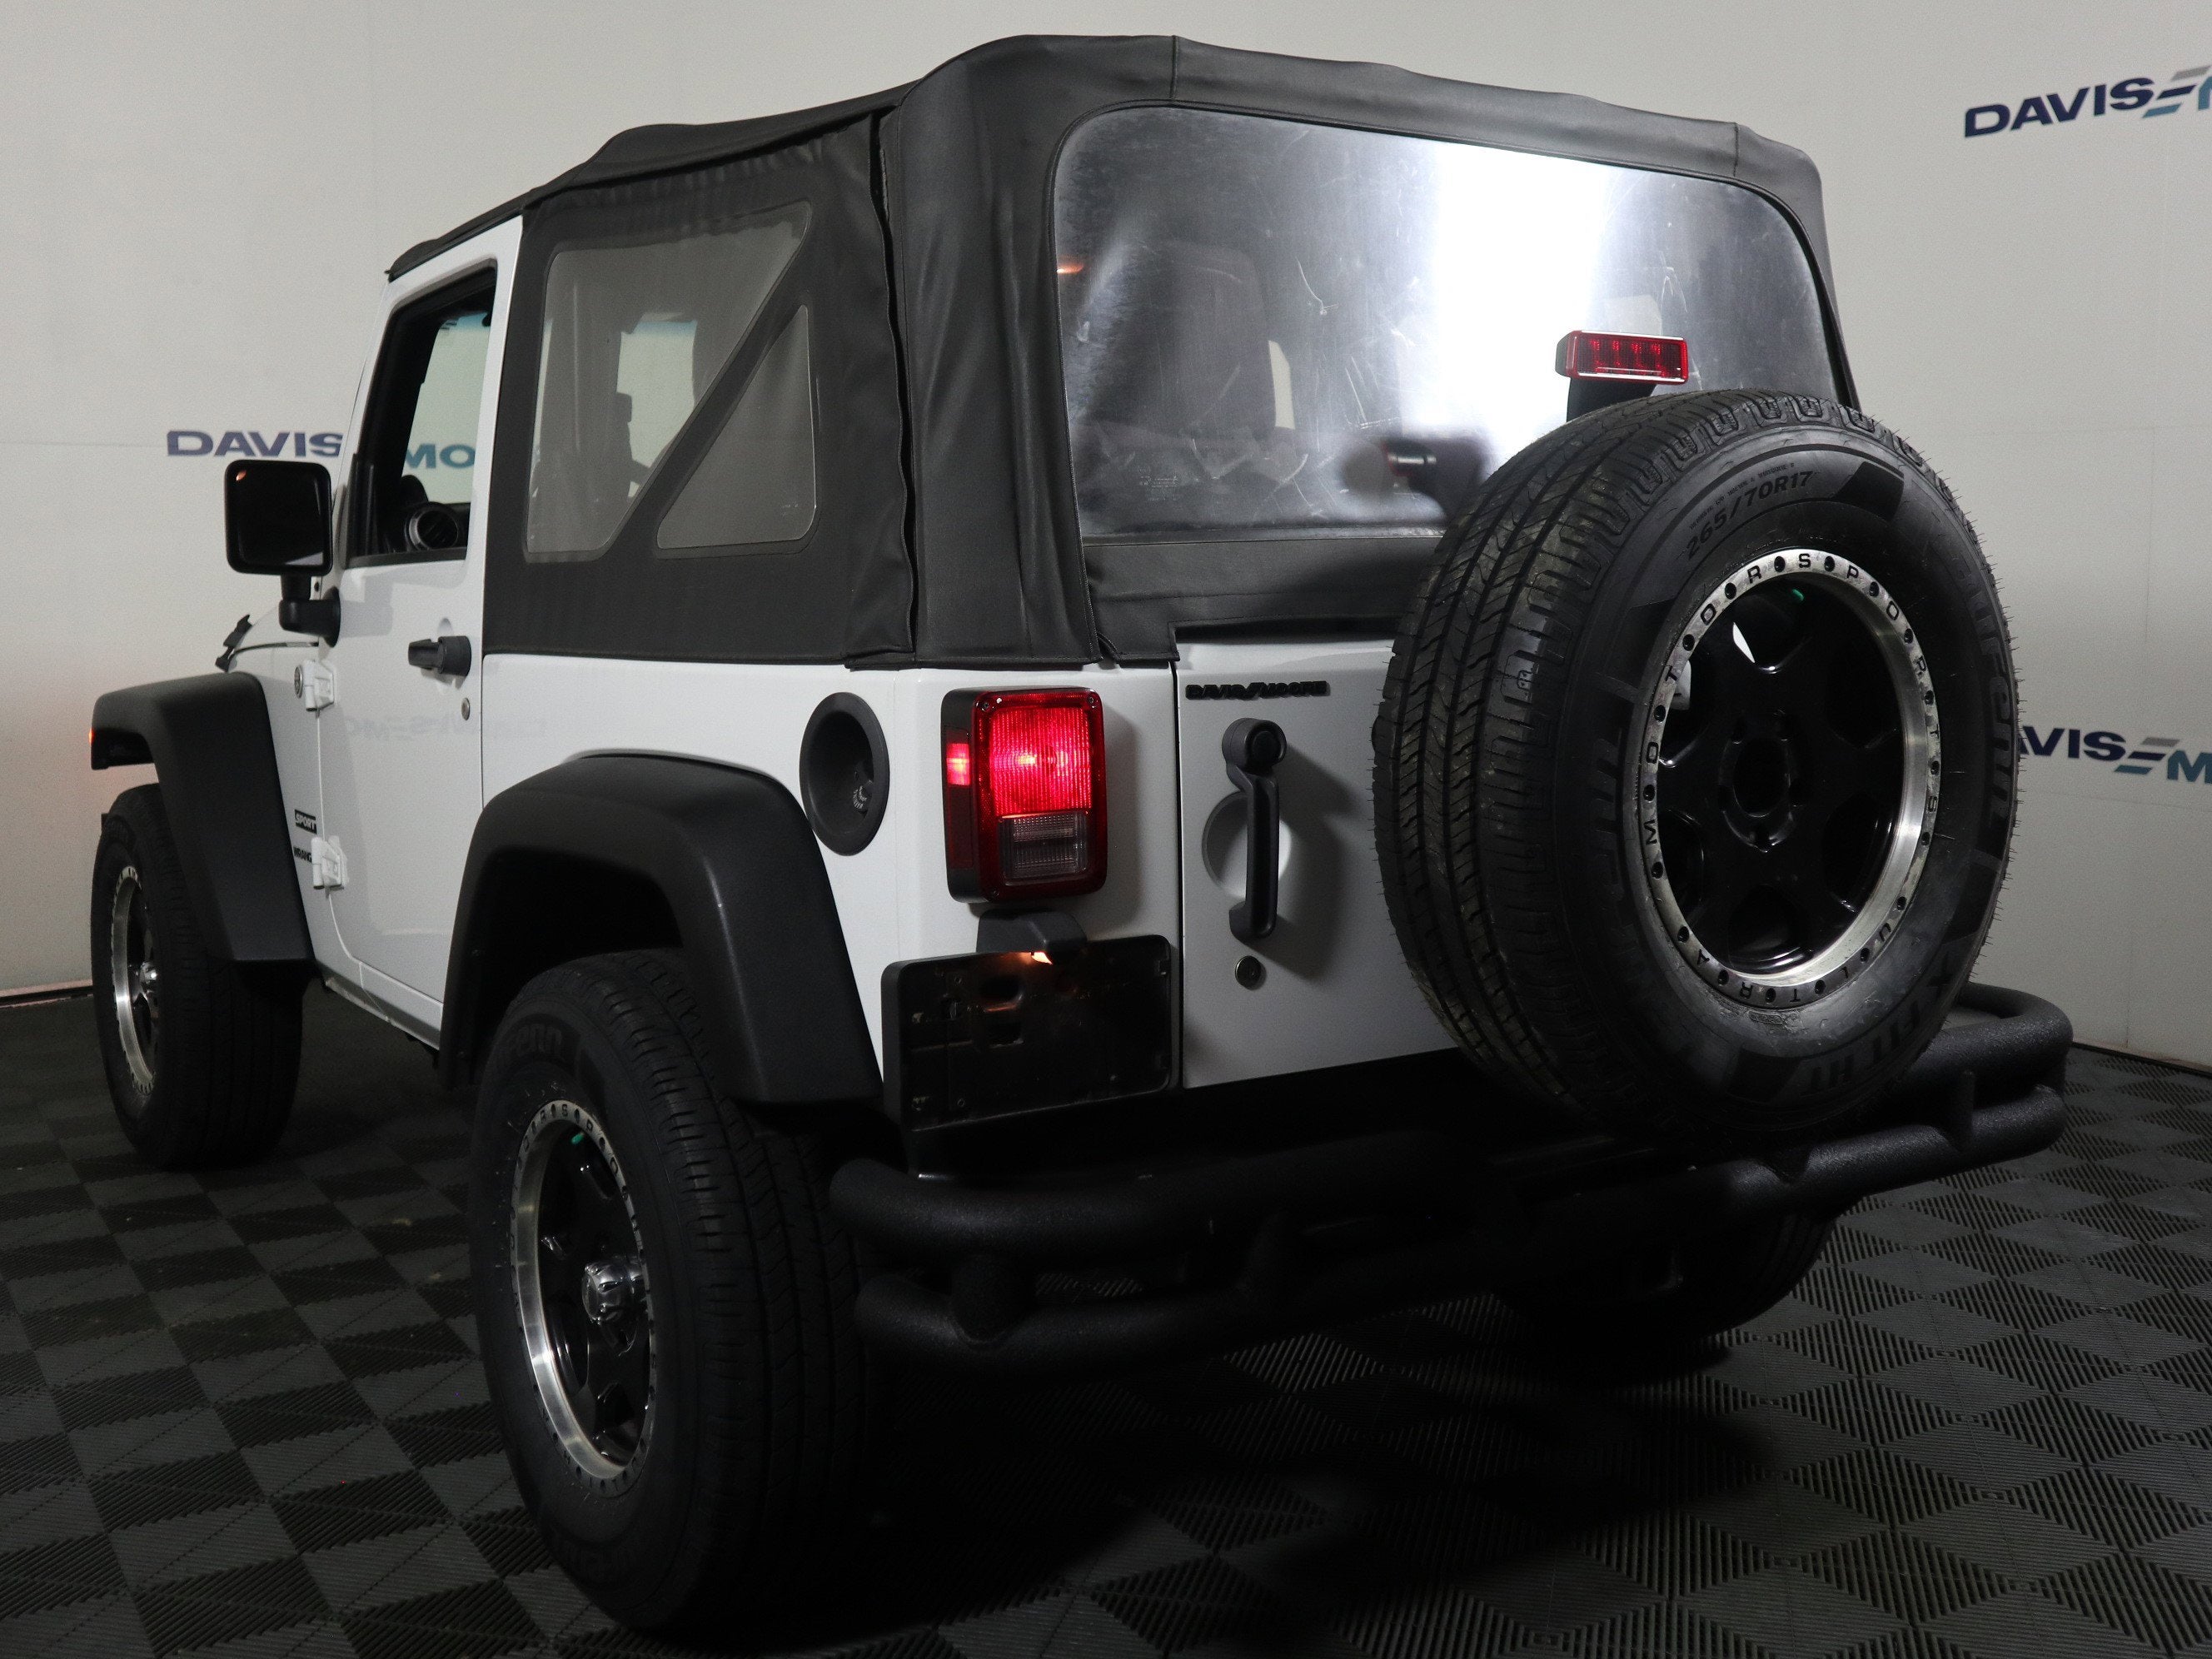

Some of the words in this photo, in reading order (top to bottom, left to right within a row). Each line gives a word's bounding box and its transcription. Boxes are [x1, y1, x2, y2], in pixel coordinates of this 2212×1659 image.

[1965, 77, 2155, 137] DAVIS
[167, 430, 343, 457] DAVIS
[1686, 471, 1815, 560] 265/70R17
[2016, 725, 2126, 761] VIS
[295, 811, 316, 831] SPORT
